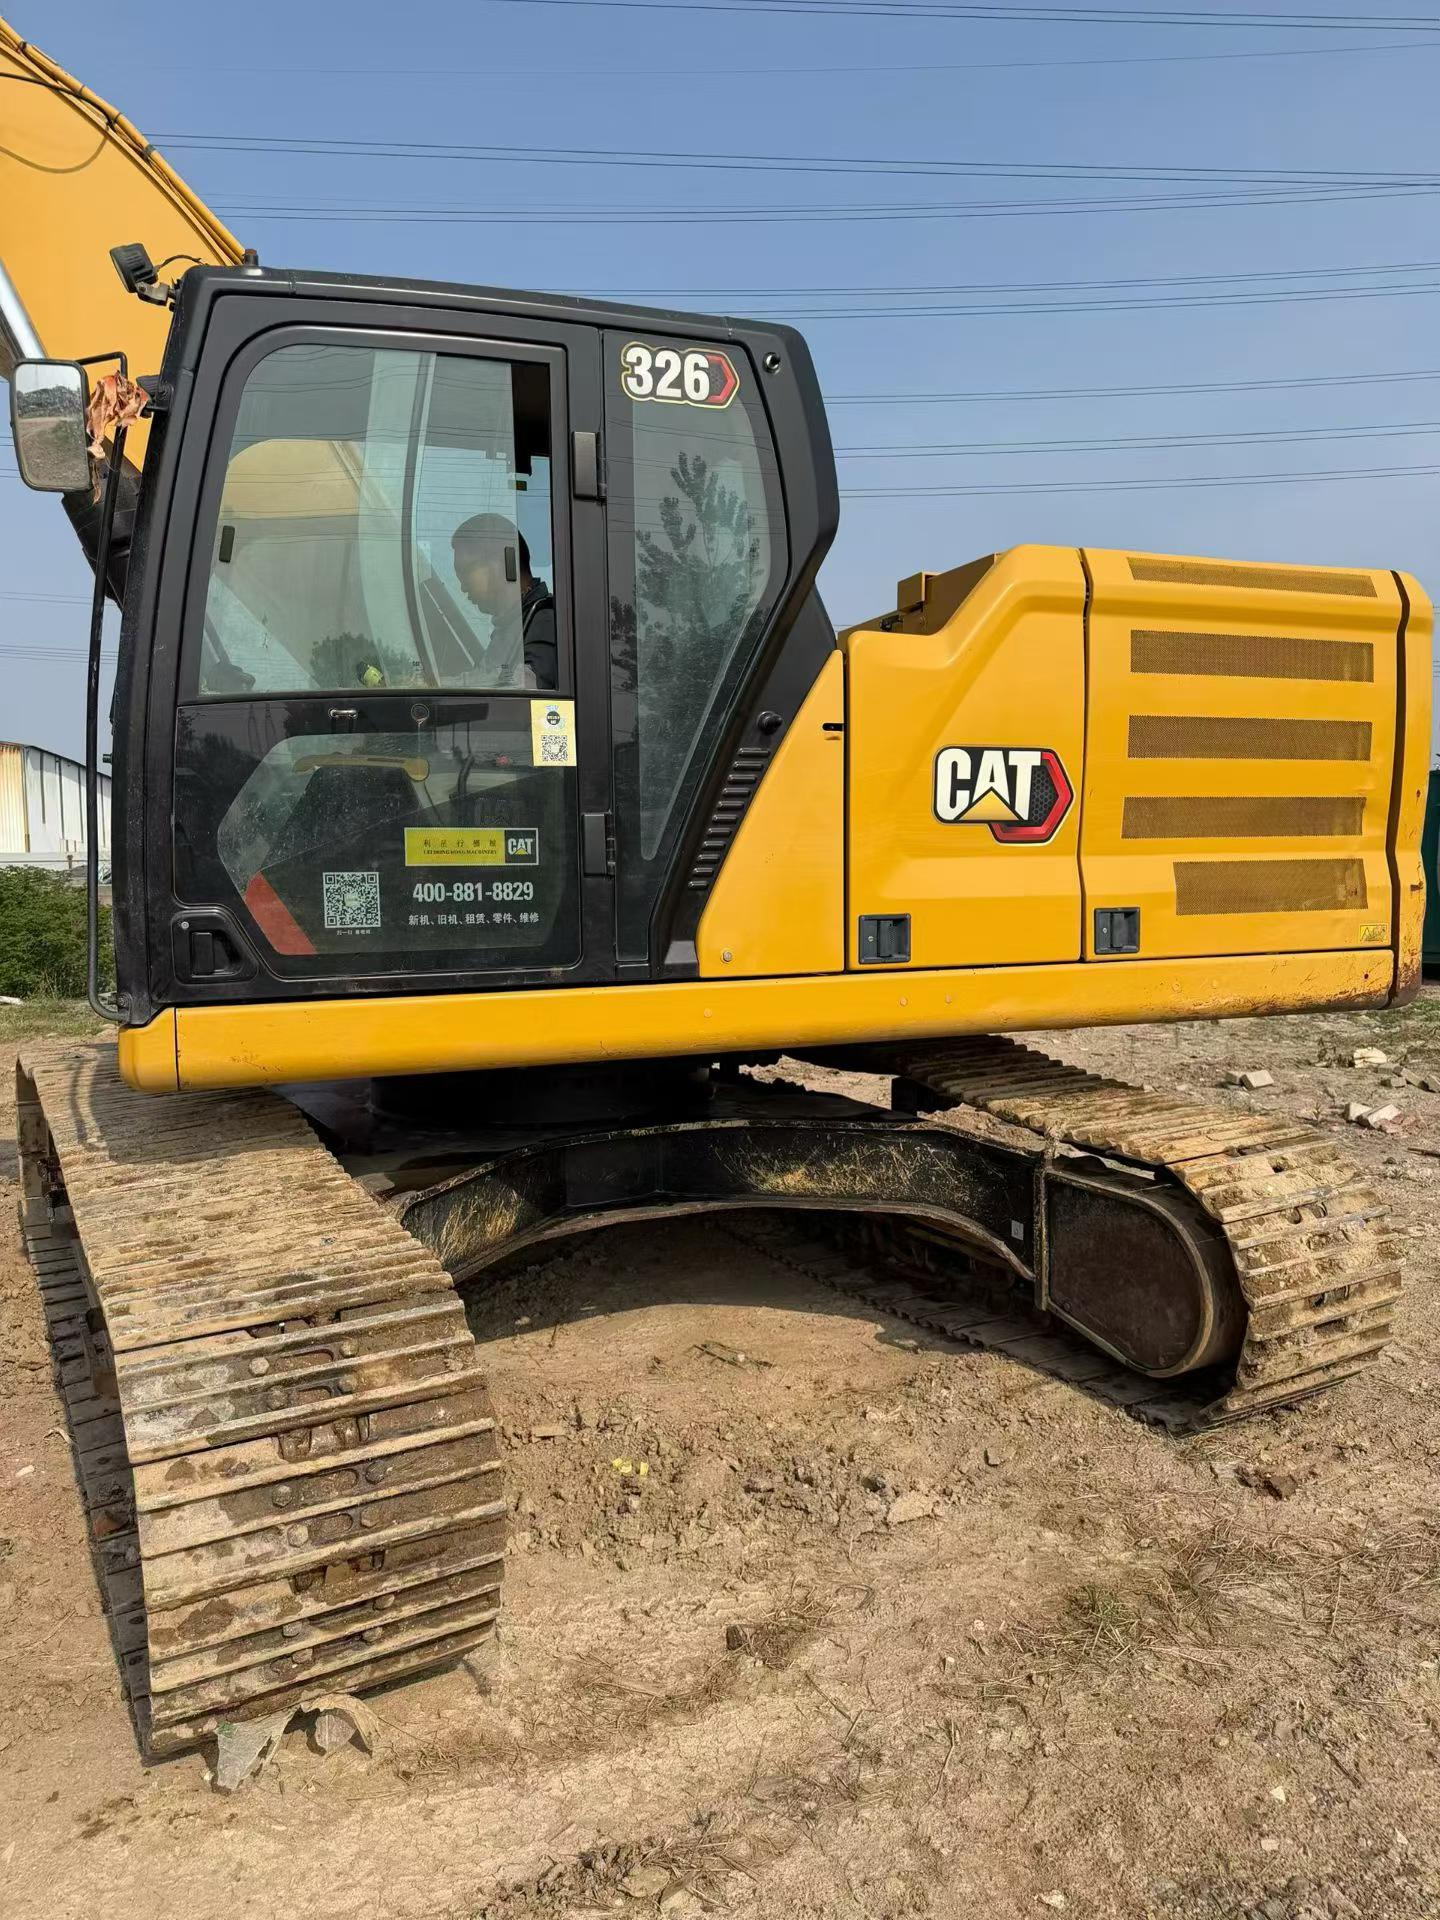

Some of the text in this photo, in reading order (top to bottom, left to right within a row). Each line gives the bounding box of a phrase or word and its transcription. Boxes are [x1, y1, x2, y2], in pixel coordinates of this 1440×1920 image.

[626, 347, 710, 401] 326
[936, 748, 1042, 821] CAT
[507, 838, 534, 855] CAT
[412, 882, 534, 902] 400-881-8829
[408, 912, 540, 926] 新机、旧机、租赁、零件、维修
